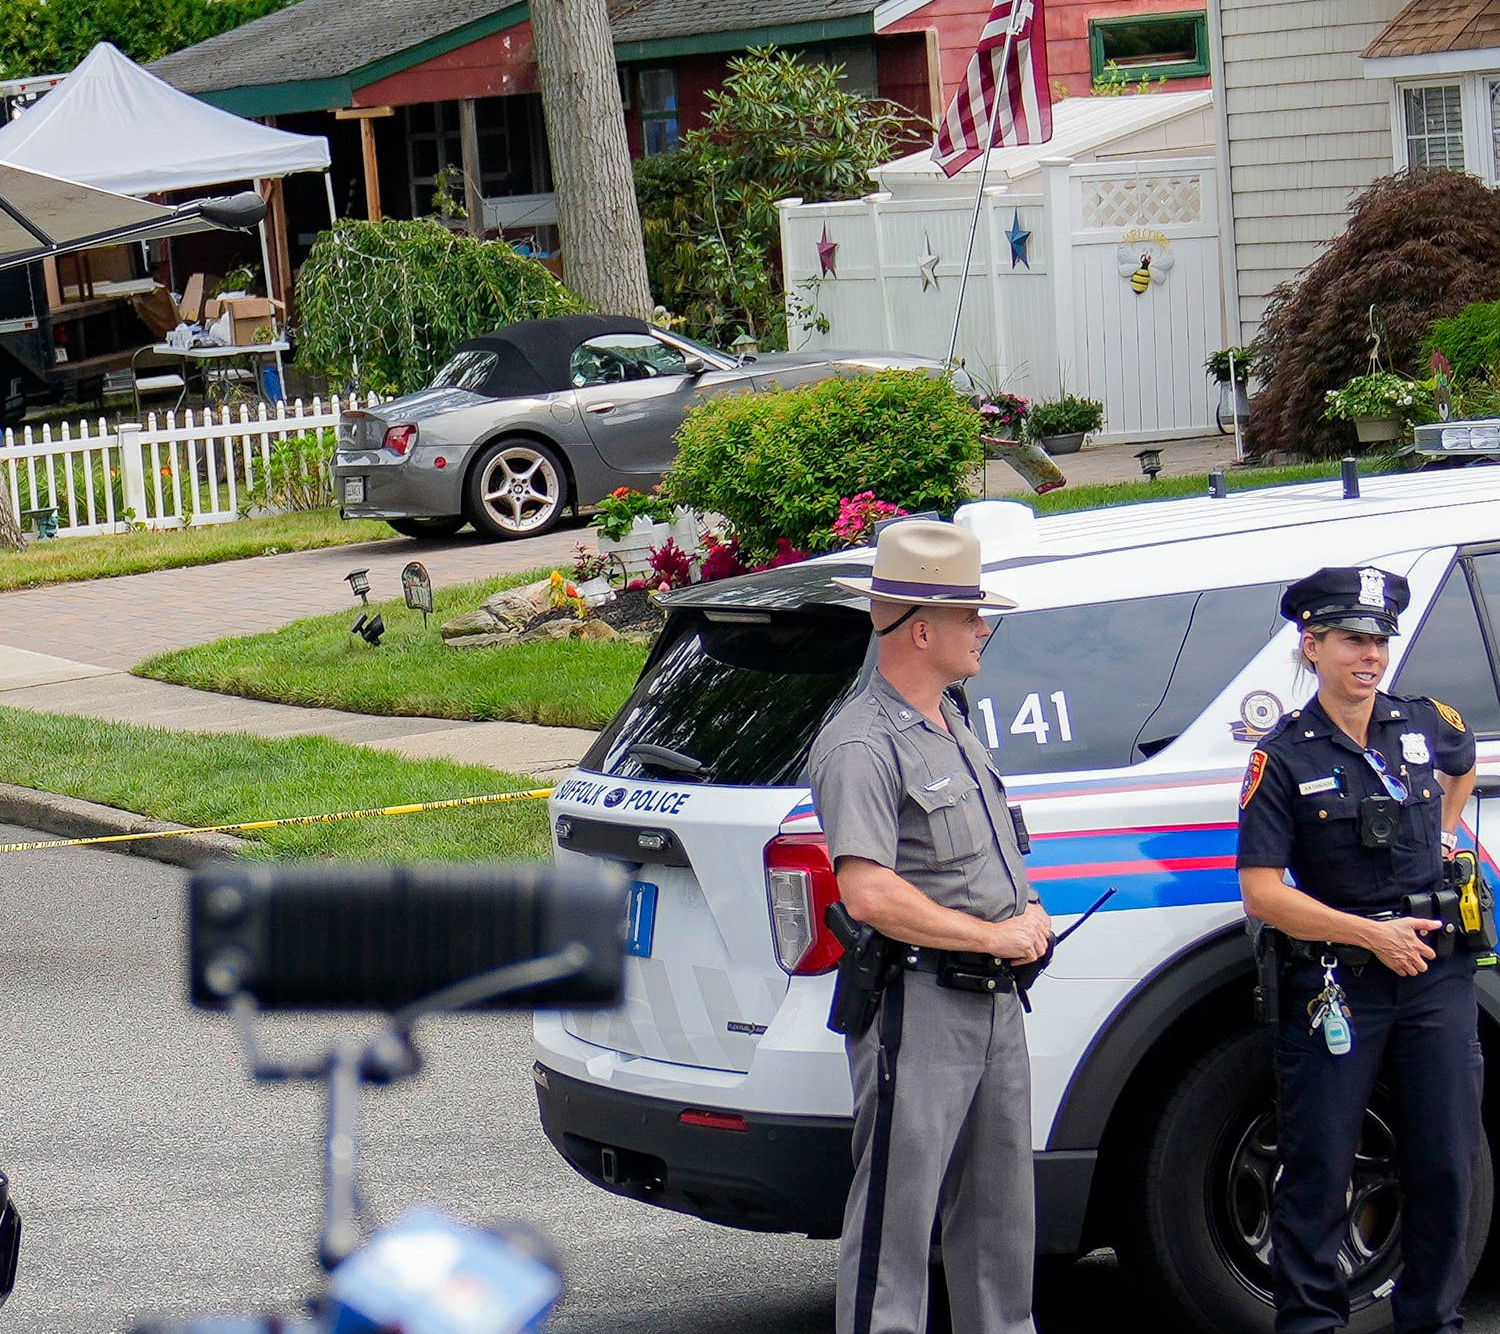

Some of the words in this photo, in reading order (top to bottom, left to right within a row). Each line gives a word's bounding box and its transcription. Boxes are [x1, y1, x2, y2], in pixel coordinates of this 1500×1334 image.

[977, 690, 1072, 749] 141
[555, 779, 608, 806] SUFFOLK
[623, 789, 691, 815] POLICE
